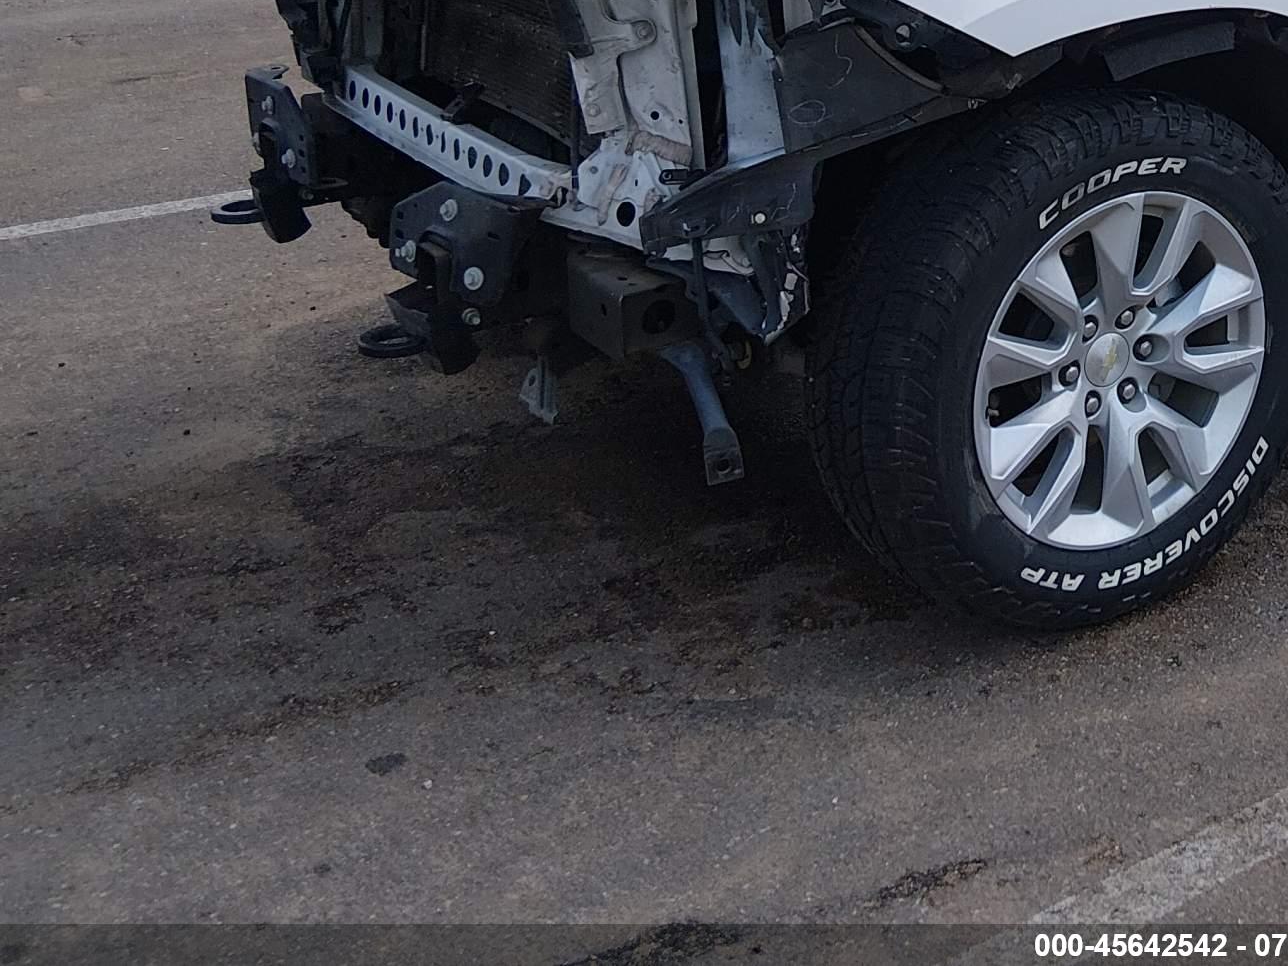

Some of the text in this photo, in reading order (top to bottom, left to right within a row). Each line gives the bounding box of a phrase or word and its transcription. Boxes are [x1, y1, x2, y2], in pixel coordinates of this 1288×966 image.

[1038, 156, 1188, 230] COOPER
[1020, 435, 1270, 592] DISCOVERER ATP
